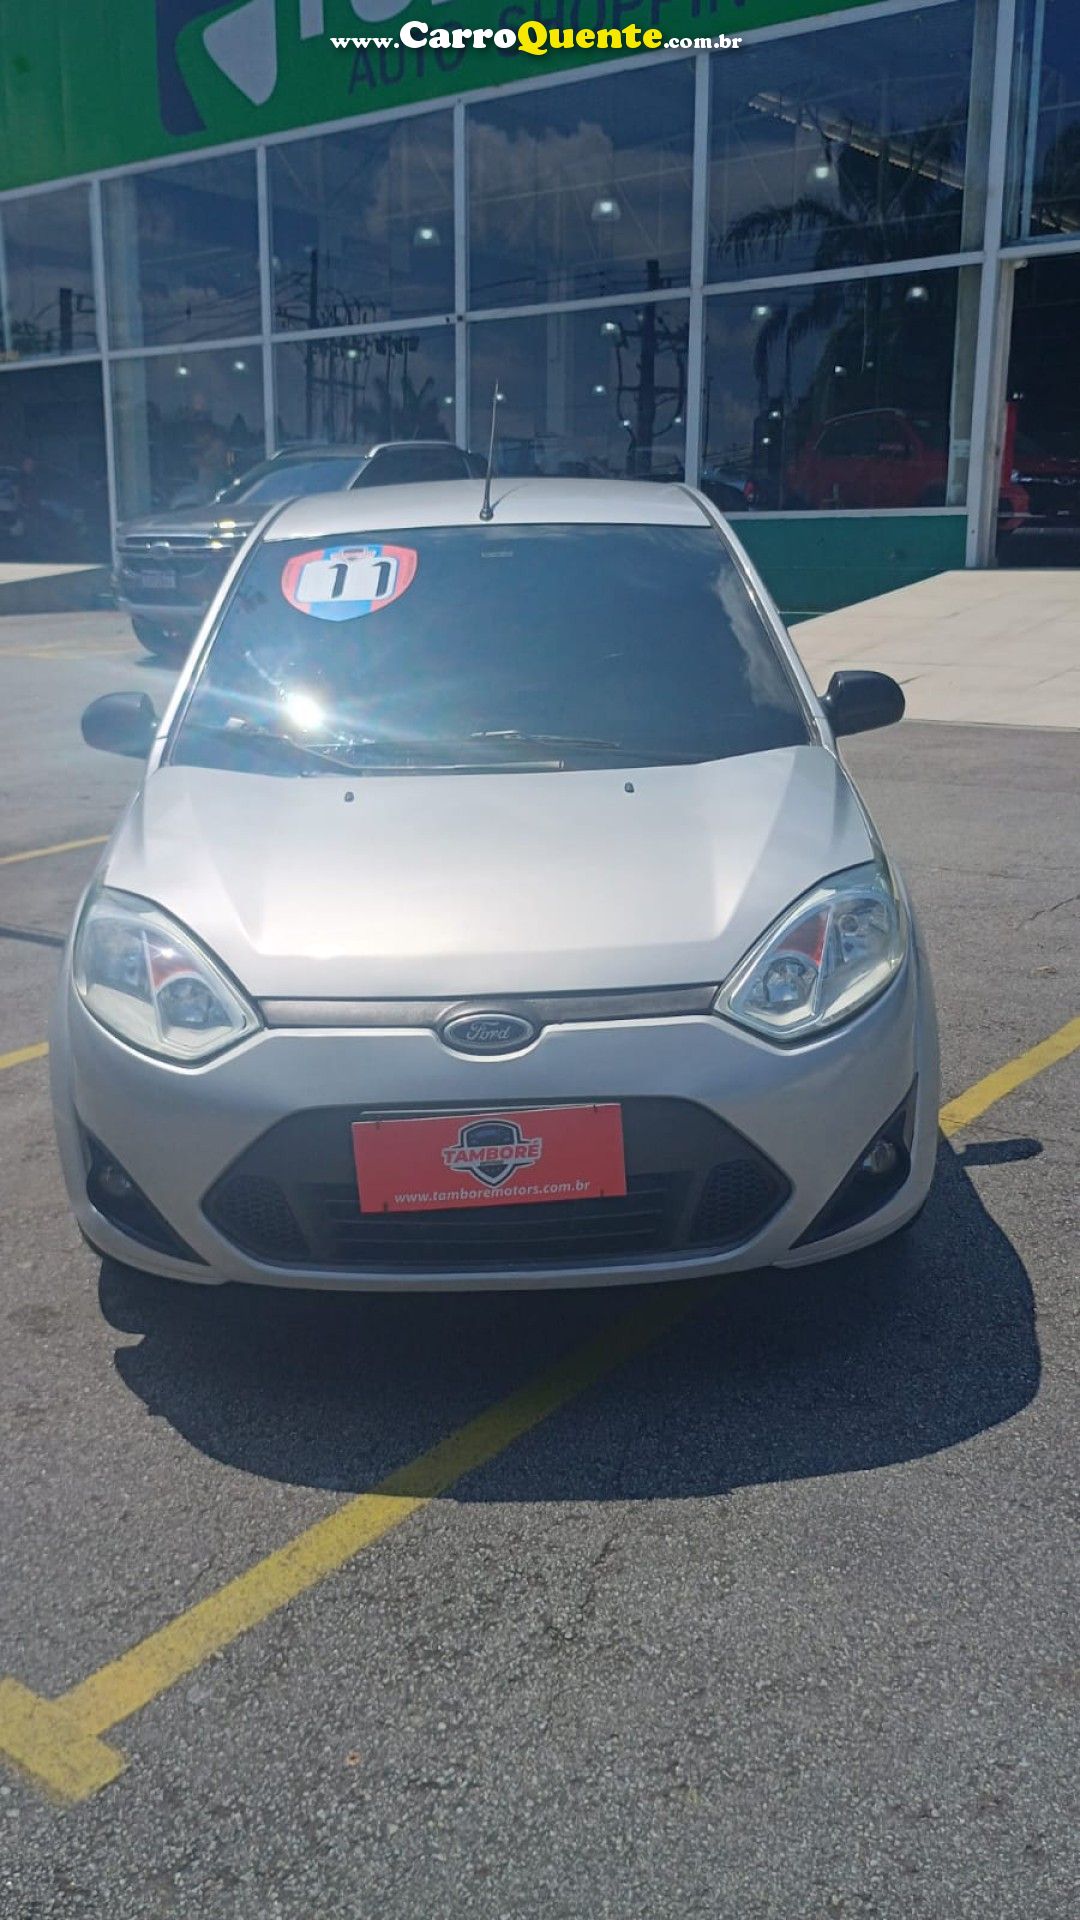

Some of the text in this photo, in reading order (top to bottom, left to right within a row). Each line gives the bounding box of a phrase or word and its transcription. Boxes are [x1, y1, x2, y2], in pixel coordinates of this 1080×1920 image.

[329, 560, 392, 599] 11
[466, 1020, 512, 1041] Ford
[443, 1138, 541, 1164] TAMBORÉ
[393, 1180, 591, 1204] www.tamboremotors.com.br
